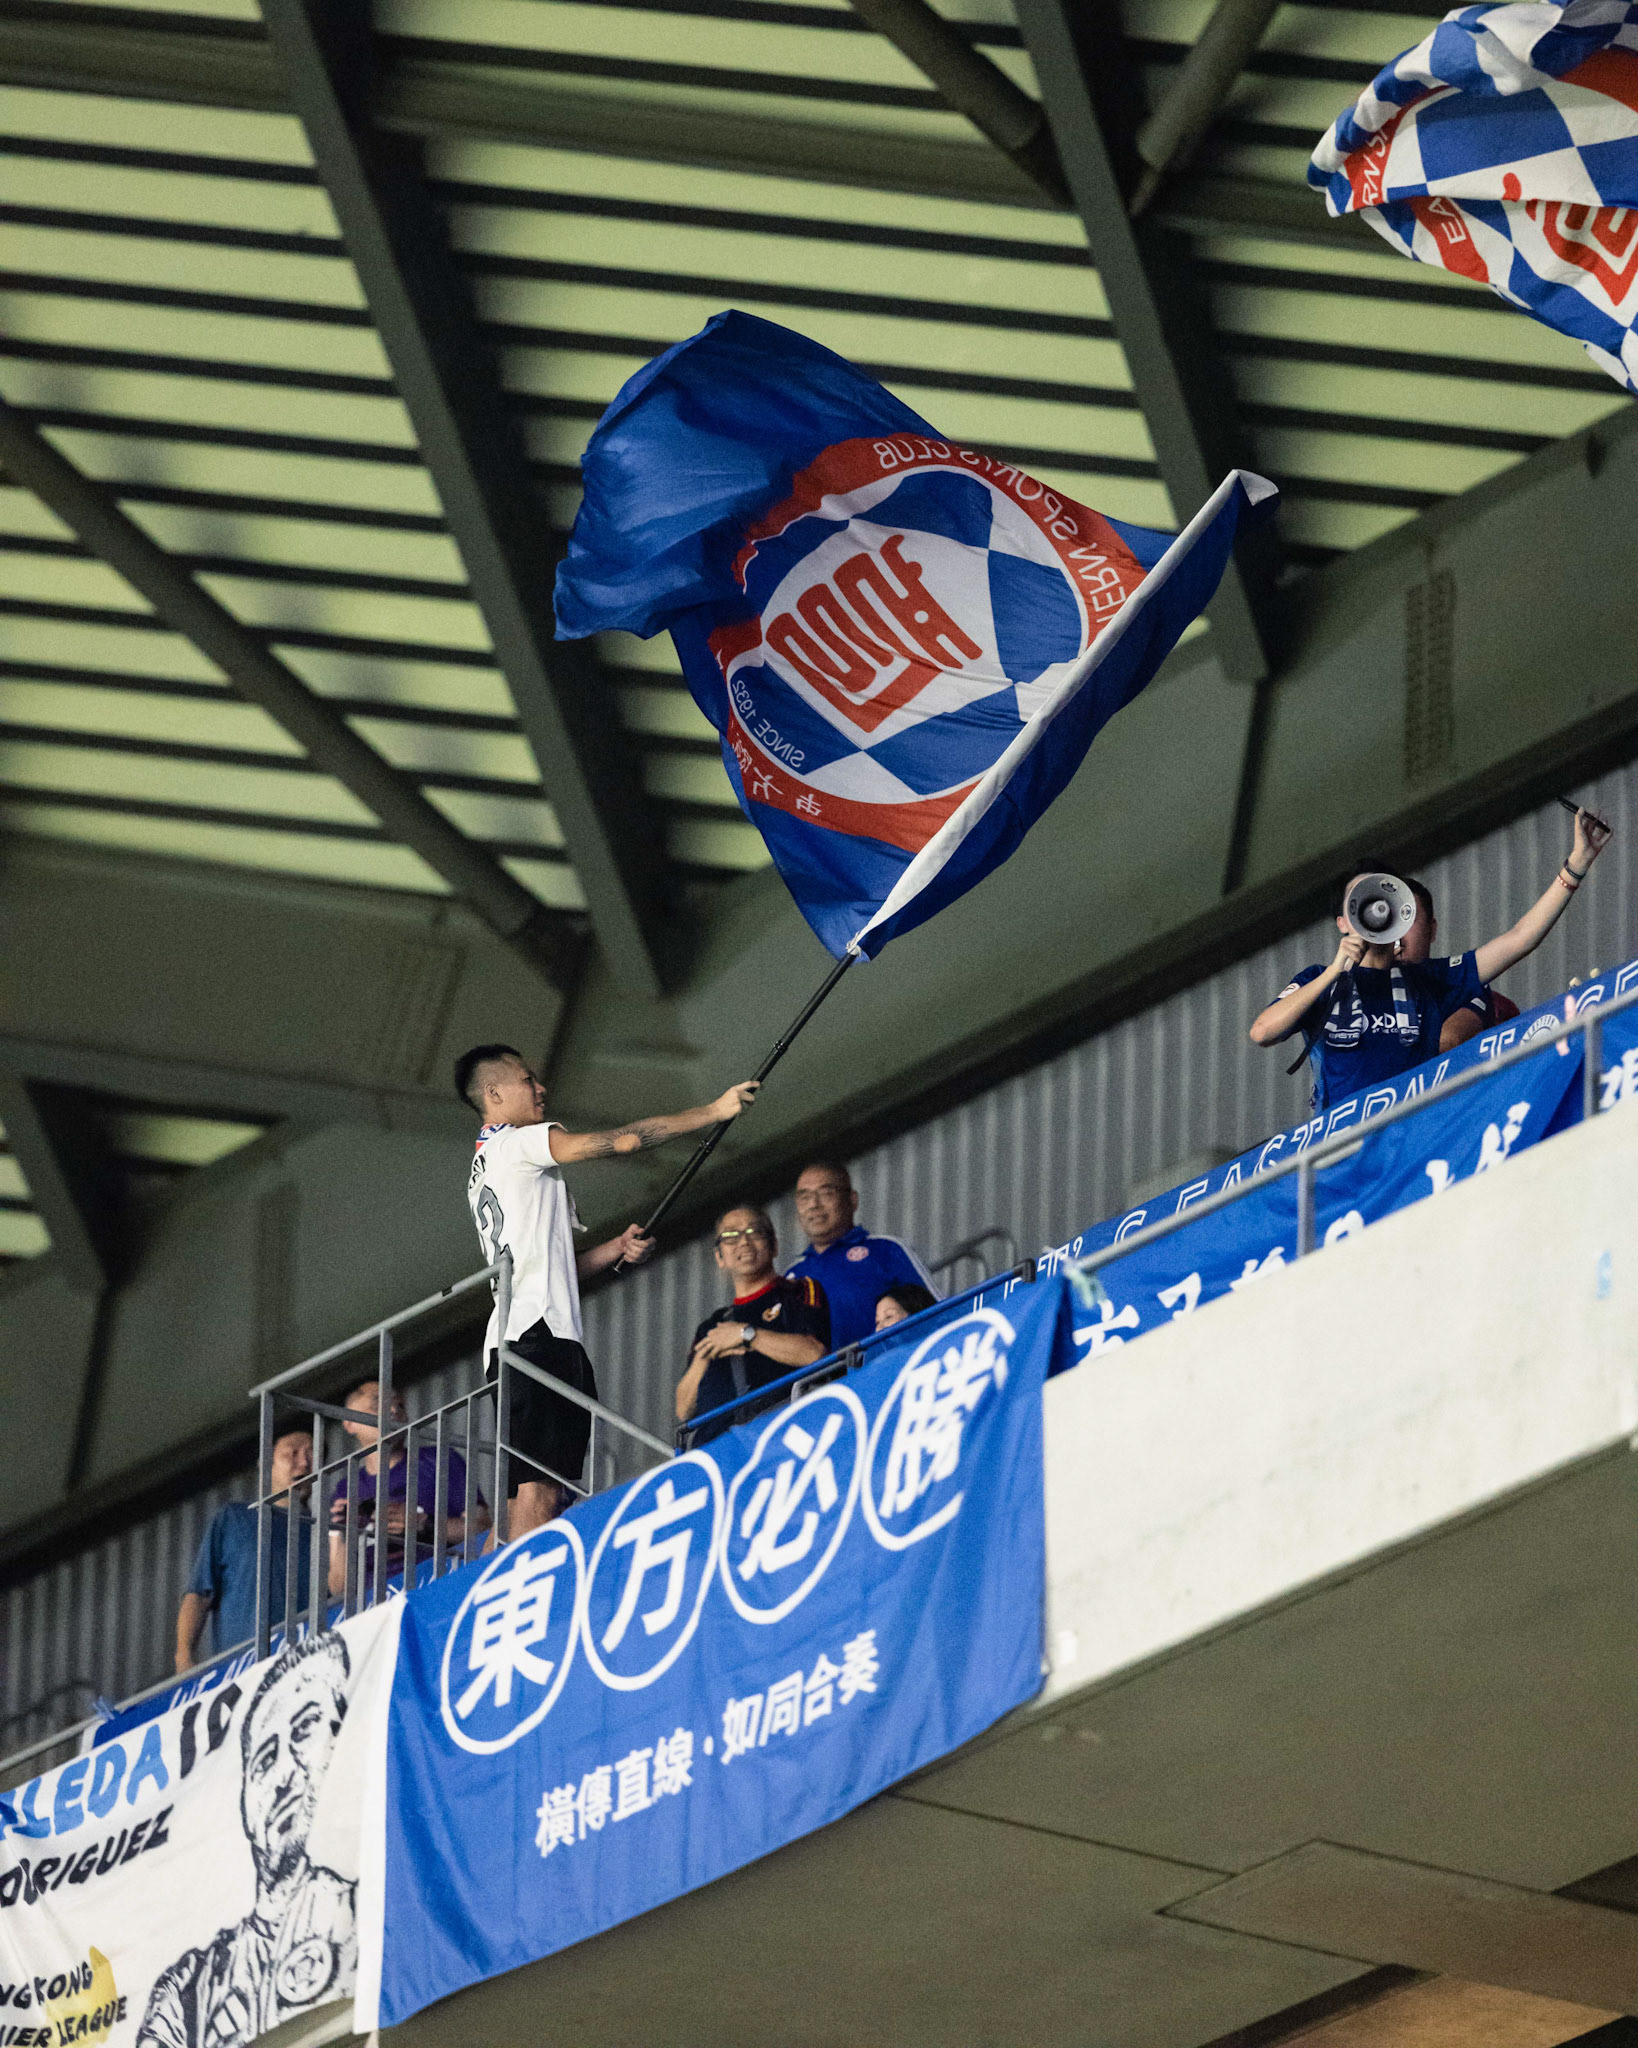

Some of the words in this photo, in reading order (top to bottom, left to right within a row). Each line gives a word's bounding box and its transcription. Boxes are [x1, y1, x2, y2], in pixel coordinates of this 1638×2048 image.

[453, 1325, 1009, 1720] 東方必勝
[56, 1995, 128, 2048] LEAGUE
